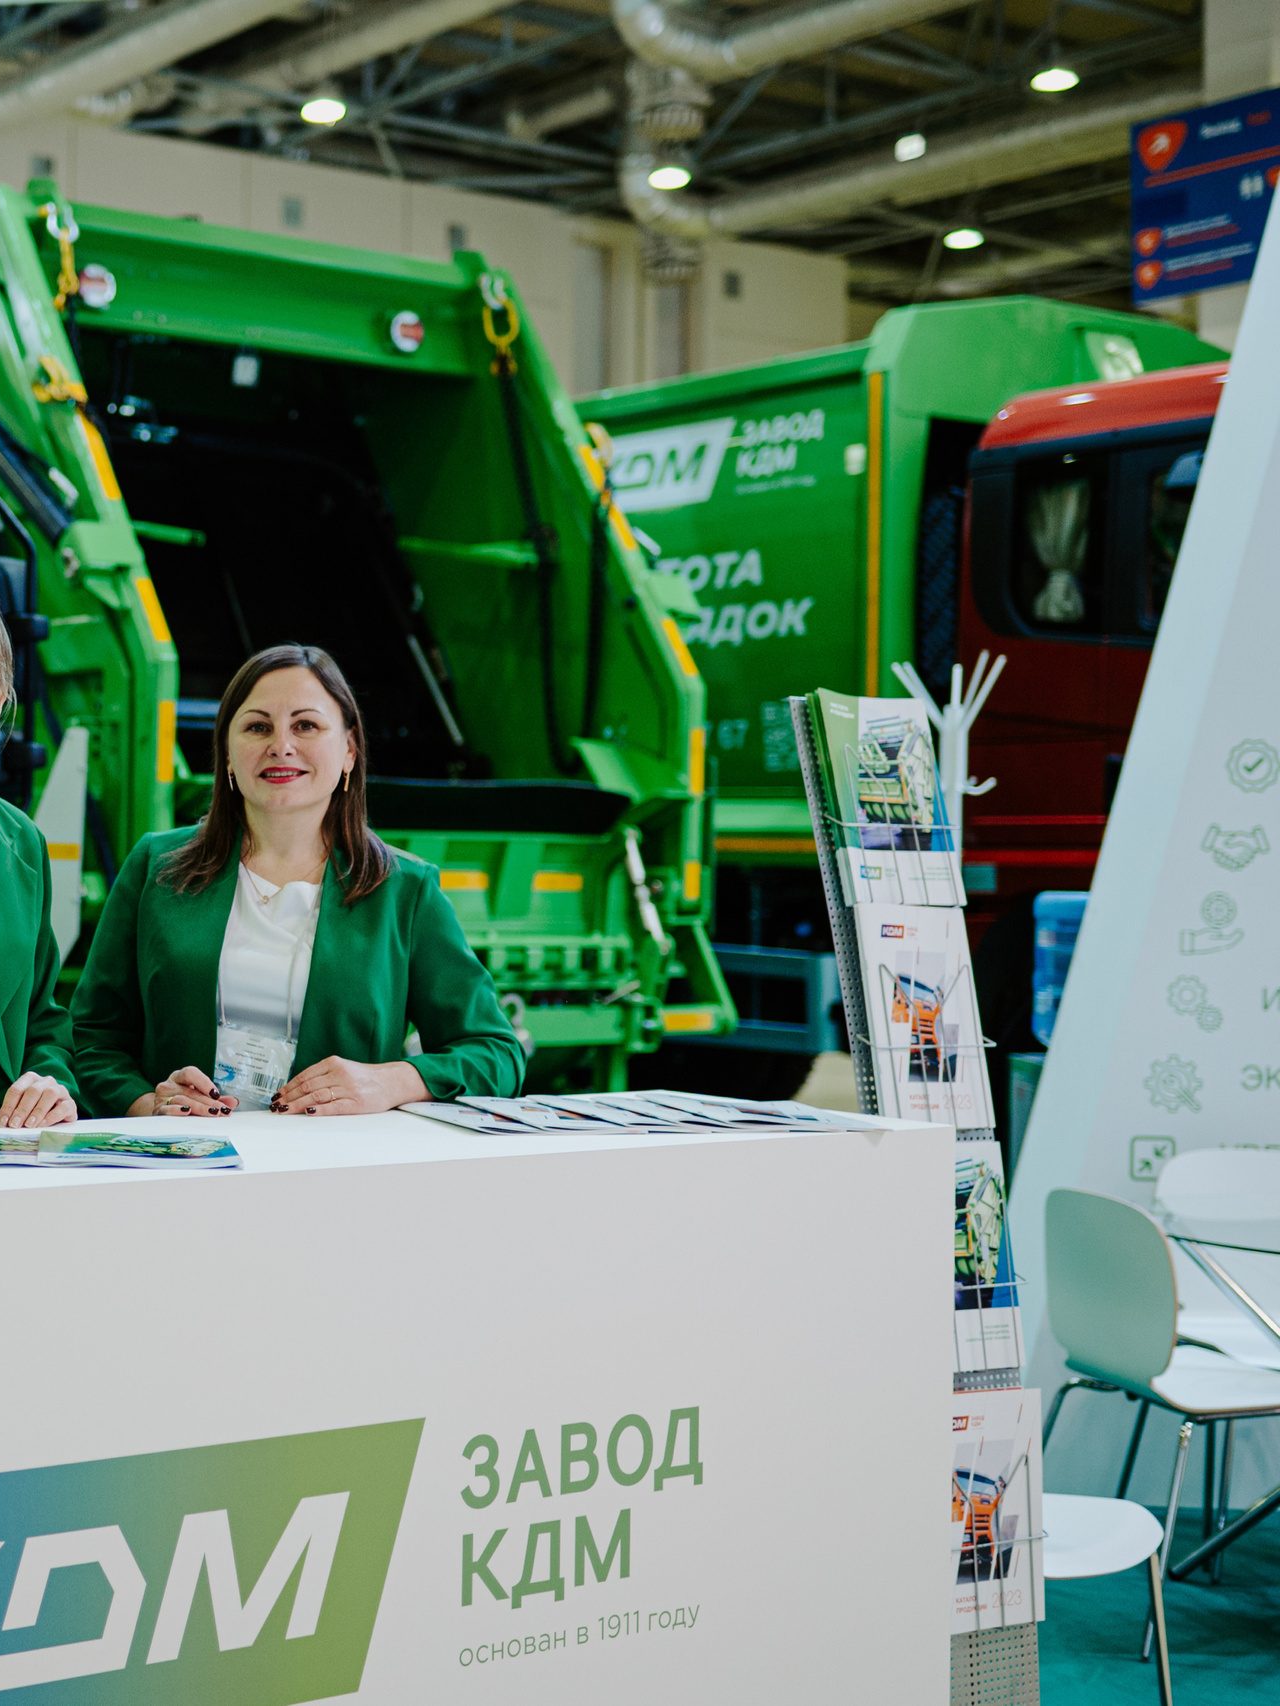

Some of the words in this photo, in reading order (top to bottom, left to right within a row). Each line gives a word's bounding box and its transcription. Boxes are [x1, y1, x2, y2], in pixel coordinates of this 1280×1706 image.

[739, 408, 825, 448] ЗАВОД
[736, 443, 797, 478] КДМ
[1262, 986, 1280, 1012] И
[1241, 1064, 1280, 1091] ЭК
[460, 1405, 704, 1510] ЗАВОД
[461, 1507, 632, 1610] КДМ
[458, 1630, 568, 1668] основан
[576, 1625, 590, 1645] в
[597, 1610, 640, 1641] 1911
[648, 1604, 701, 1632] году
